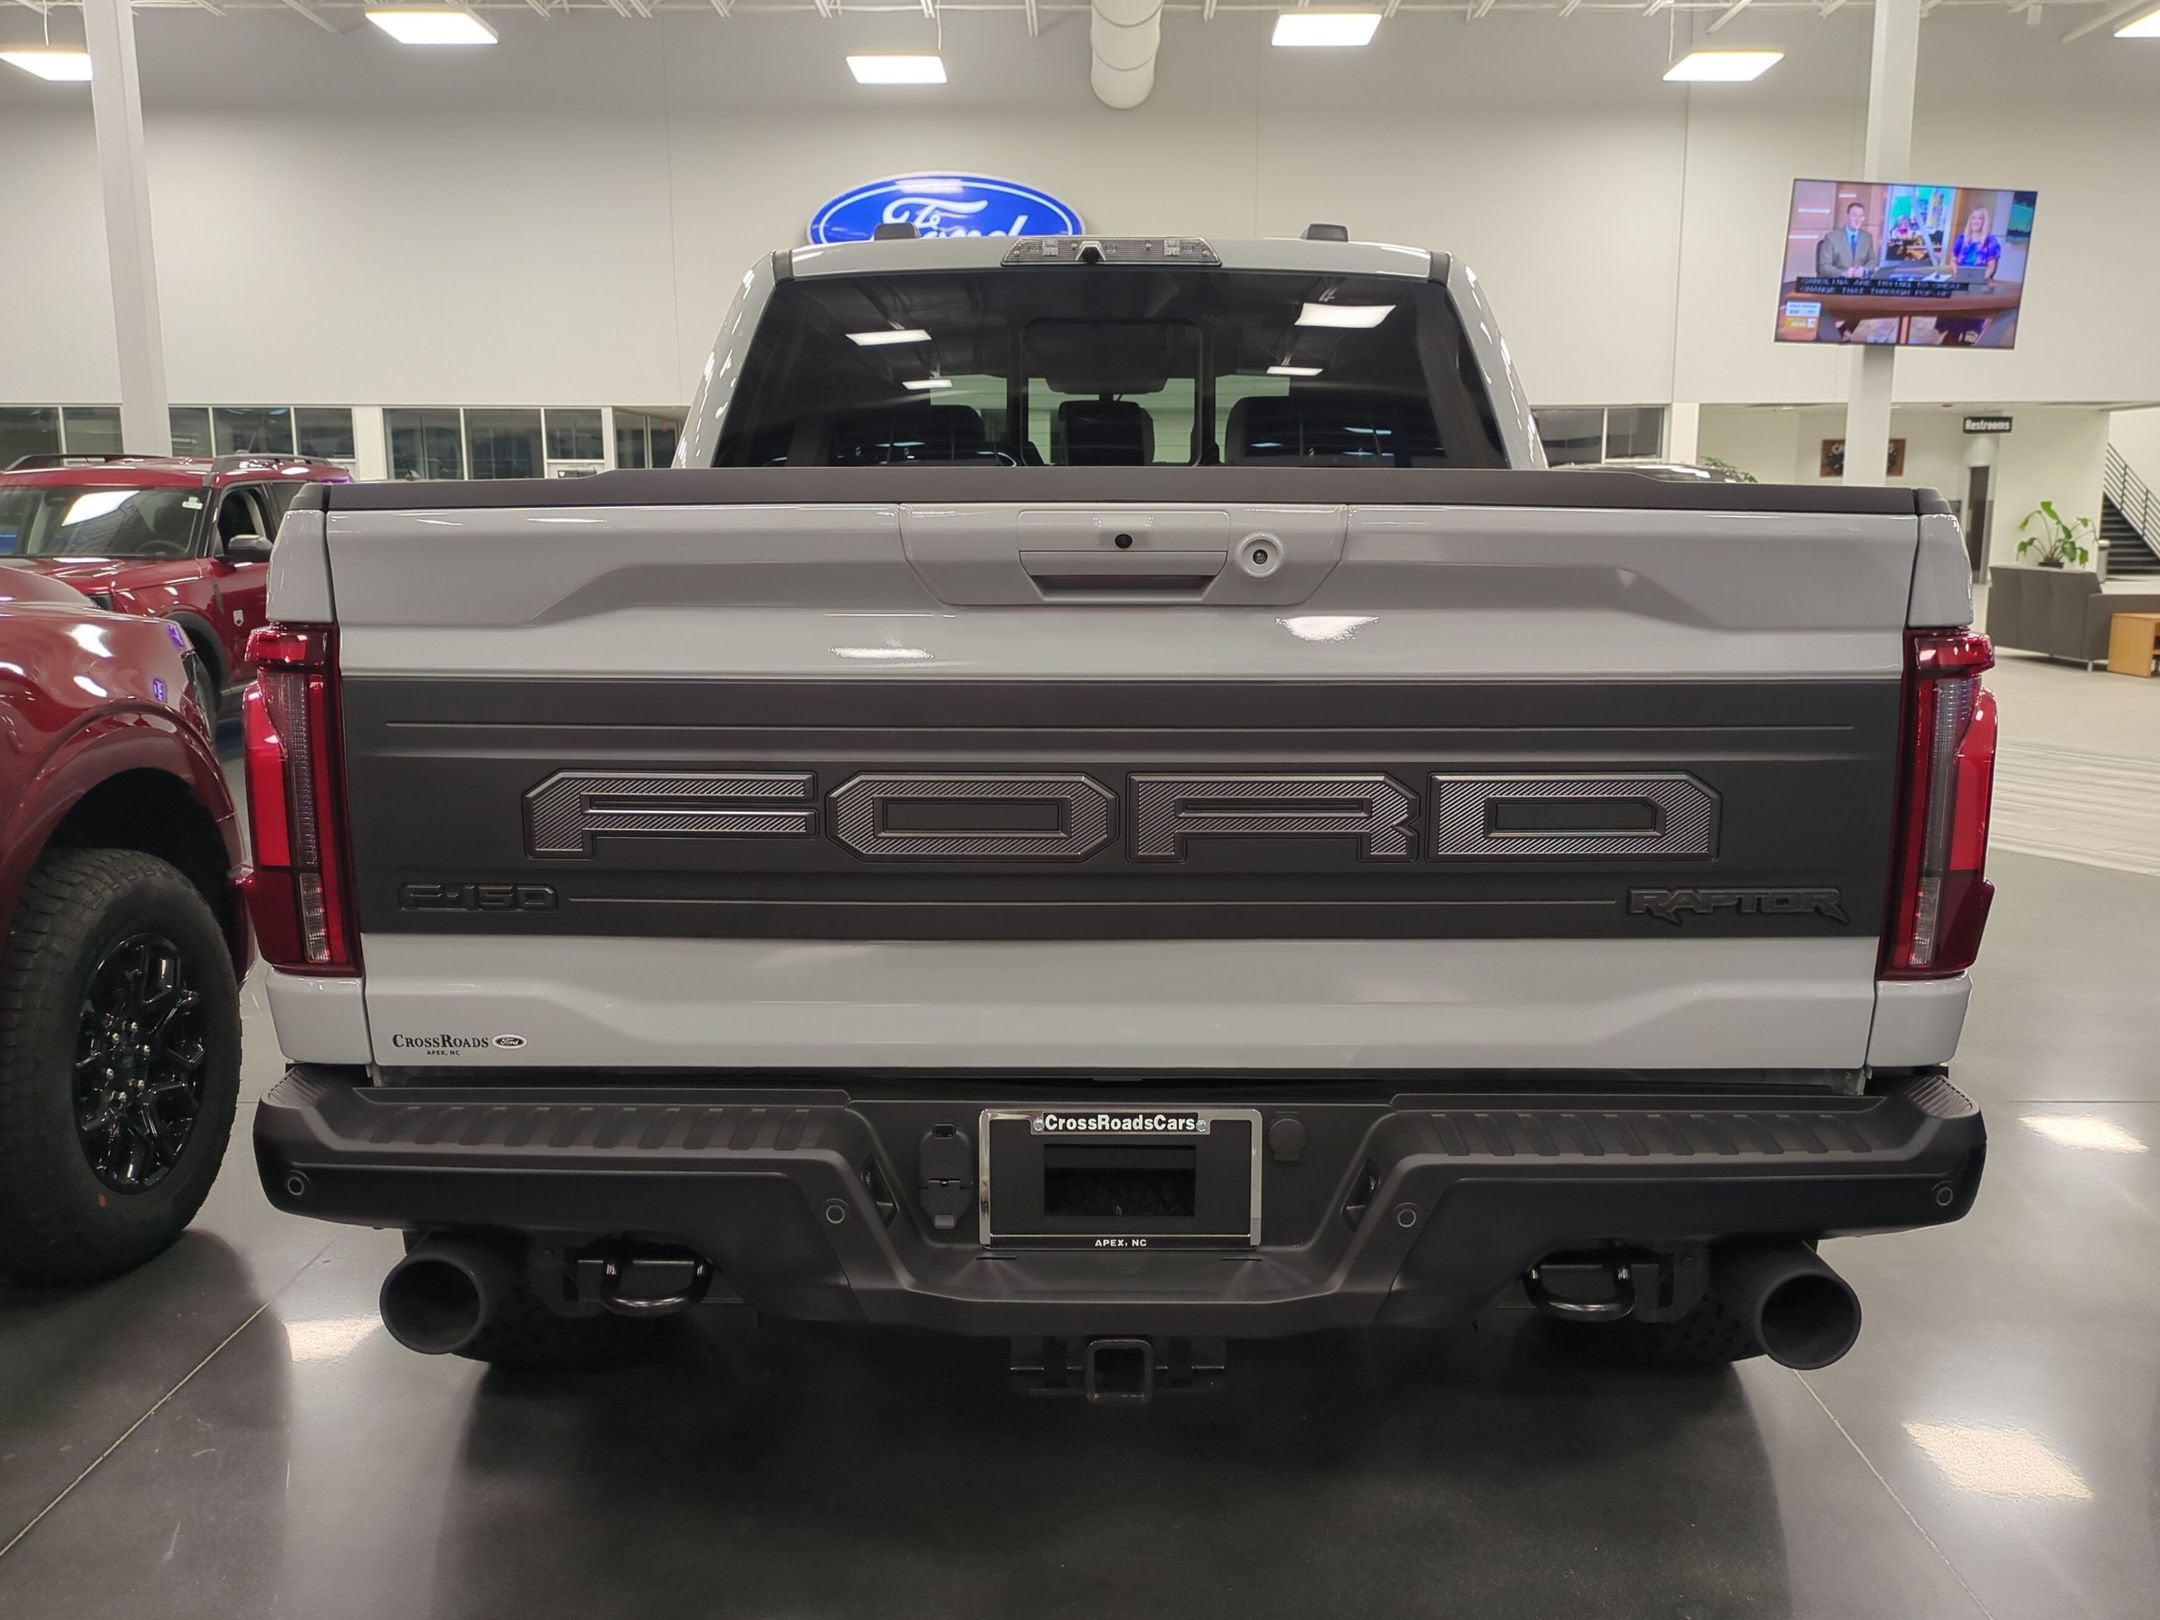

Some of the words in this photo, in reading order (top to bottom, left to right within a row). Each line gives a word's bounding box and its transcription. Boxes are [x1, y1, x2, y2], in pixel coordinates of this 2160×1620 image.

[1965, 419, 2009, 430] Restrooms
[527, 770, 1720, 860] FORD
[400, 884, 559, 912] F-150
[1627, 887, 1850, 926] RAPTOR
[1045, 1114, 1195, 1131] CrossRoadsCars
[1094, 1238, 1129, 1248] APEX,
[1131, 1238, 1148, 1248] NC
